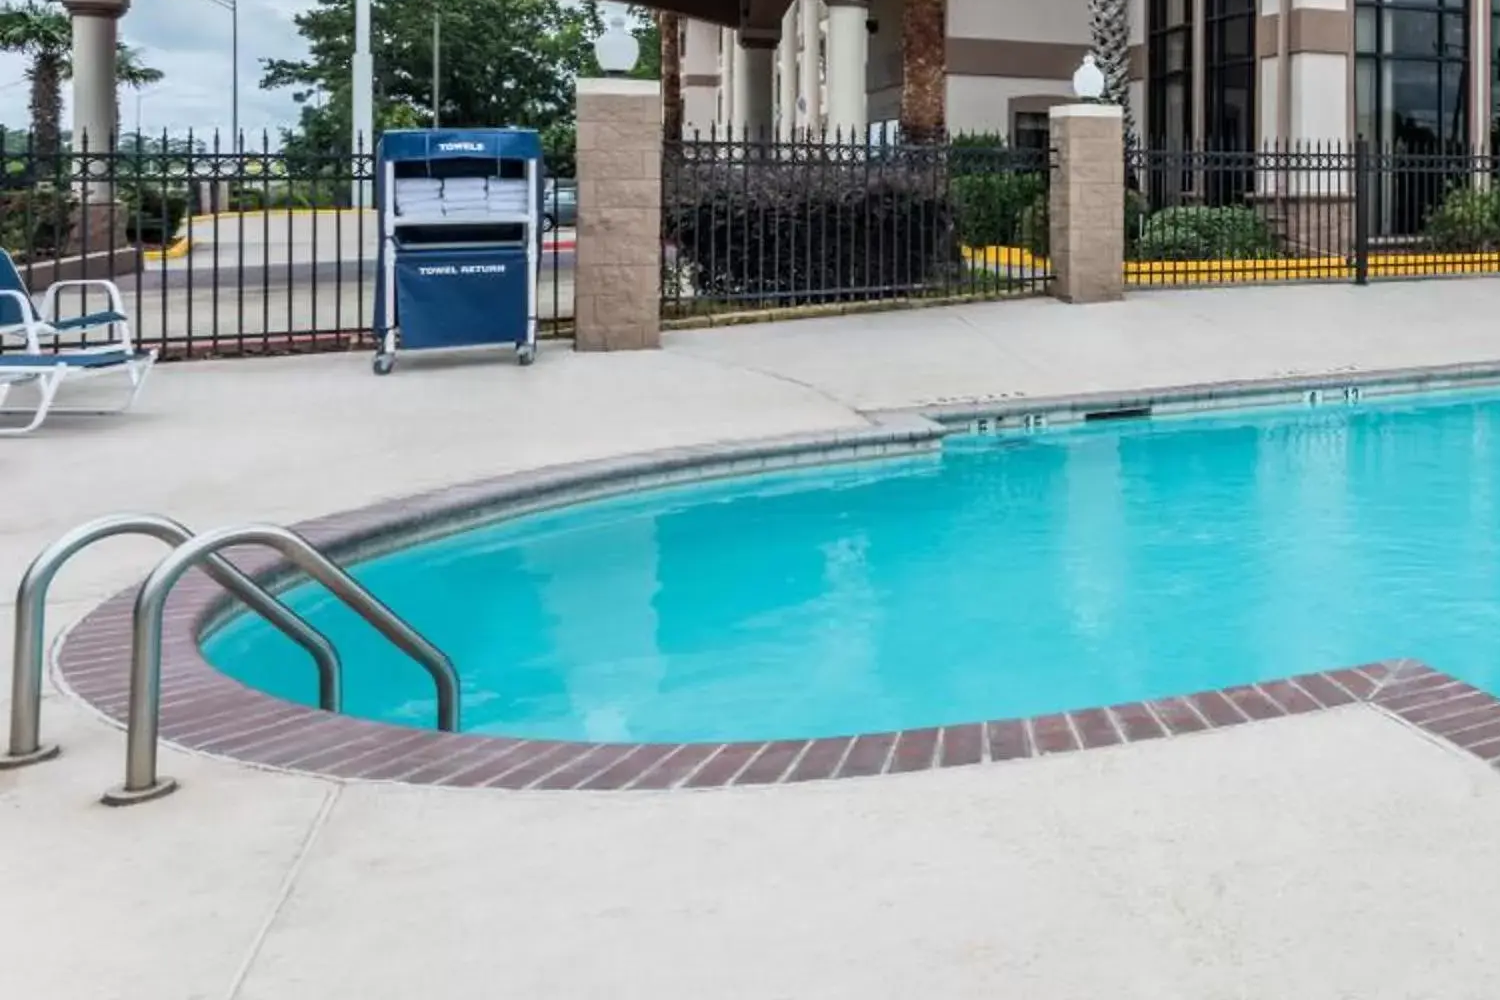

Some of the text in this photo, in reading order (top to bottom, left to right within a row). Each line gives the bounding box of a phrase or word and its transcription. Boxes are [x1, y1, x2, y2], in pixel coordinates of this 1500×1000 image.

[438, 142, 485, 151] TOWELS
[418, 264, 506, 276] TOWEL RETURN
